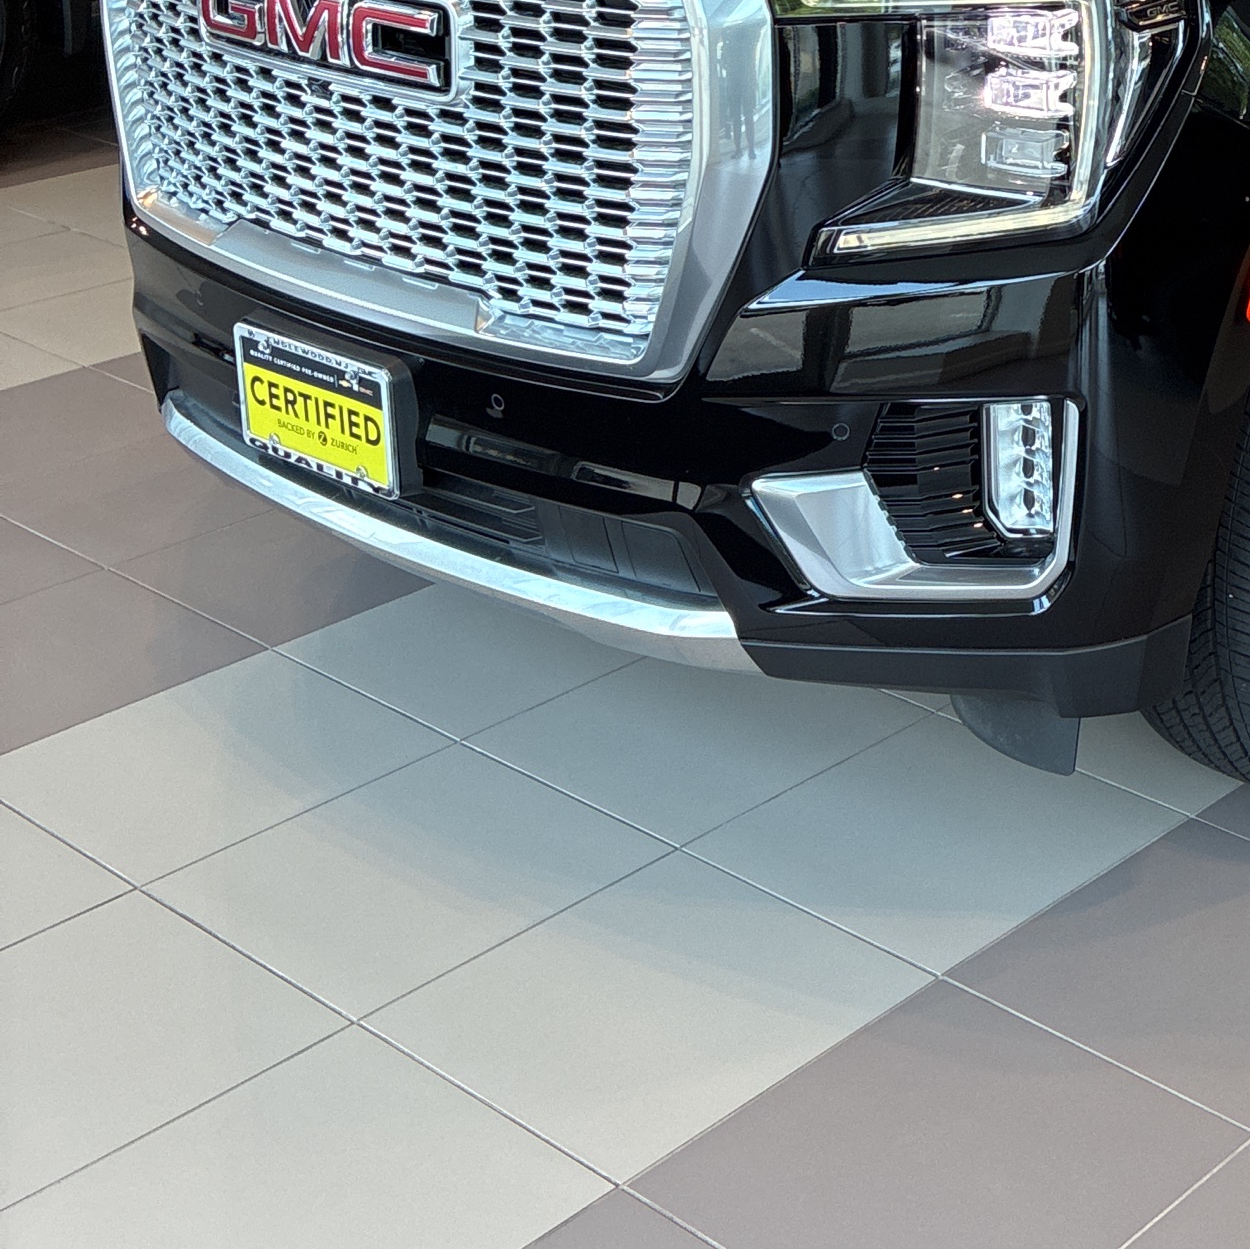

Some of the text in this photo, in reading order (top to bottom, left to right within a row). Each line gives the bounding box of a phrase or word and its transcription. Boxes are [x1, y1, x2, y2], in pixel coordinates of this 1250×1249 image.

[1146, 1, 1179, 18] GMC
[249, 375, 381, 447] CERTIFIED
[277, 418, 306, 437] BACKED
[306, 430, 316, 440] BY
[330, 438, 358, 455] ZURICH
[249, 437, 386, 495] QUALITY
